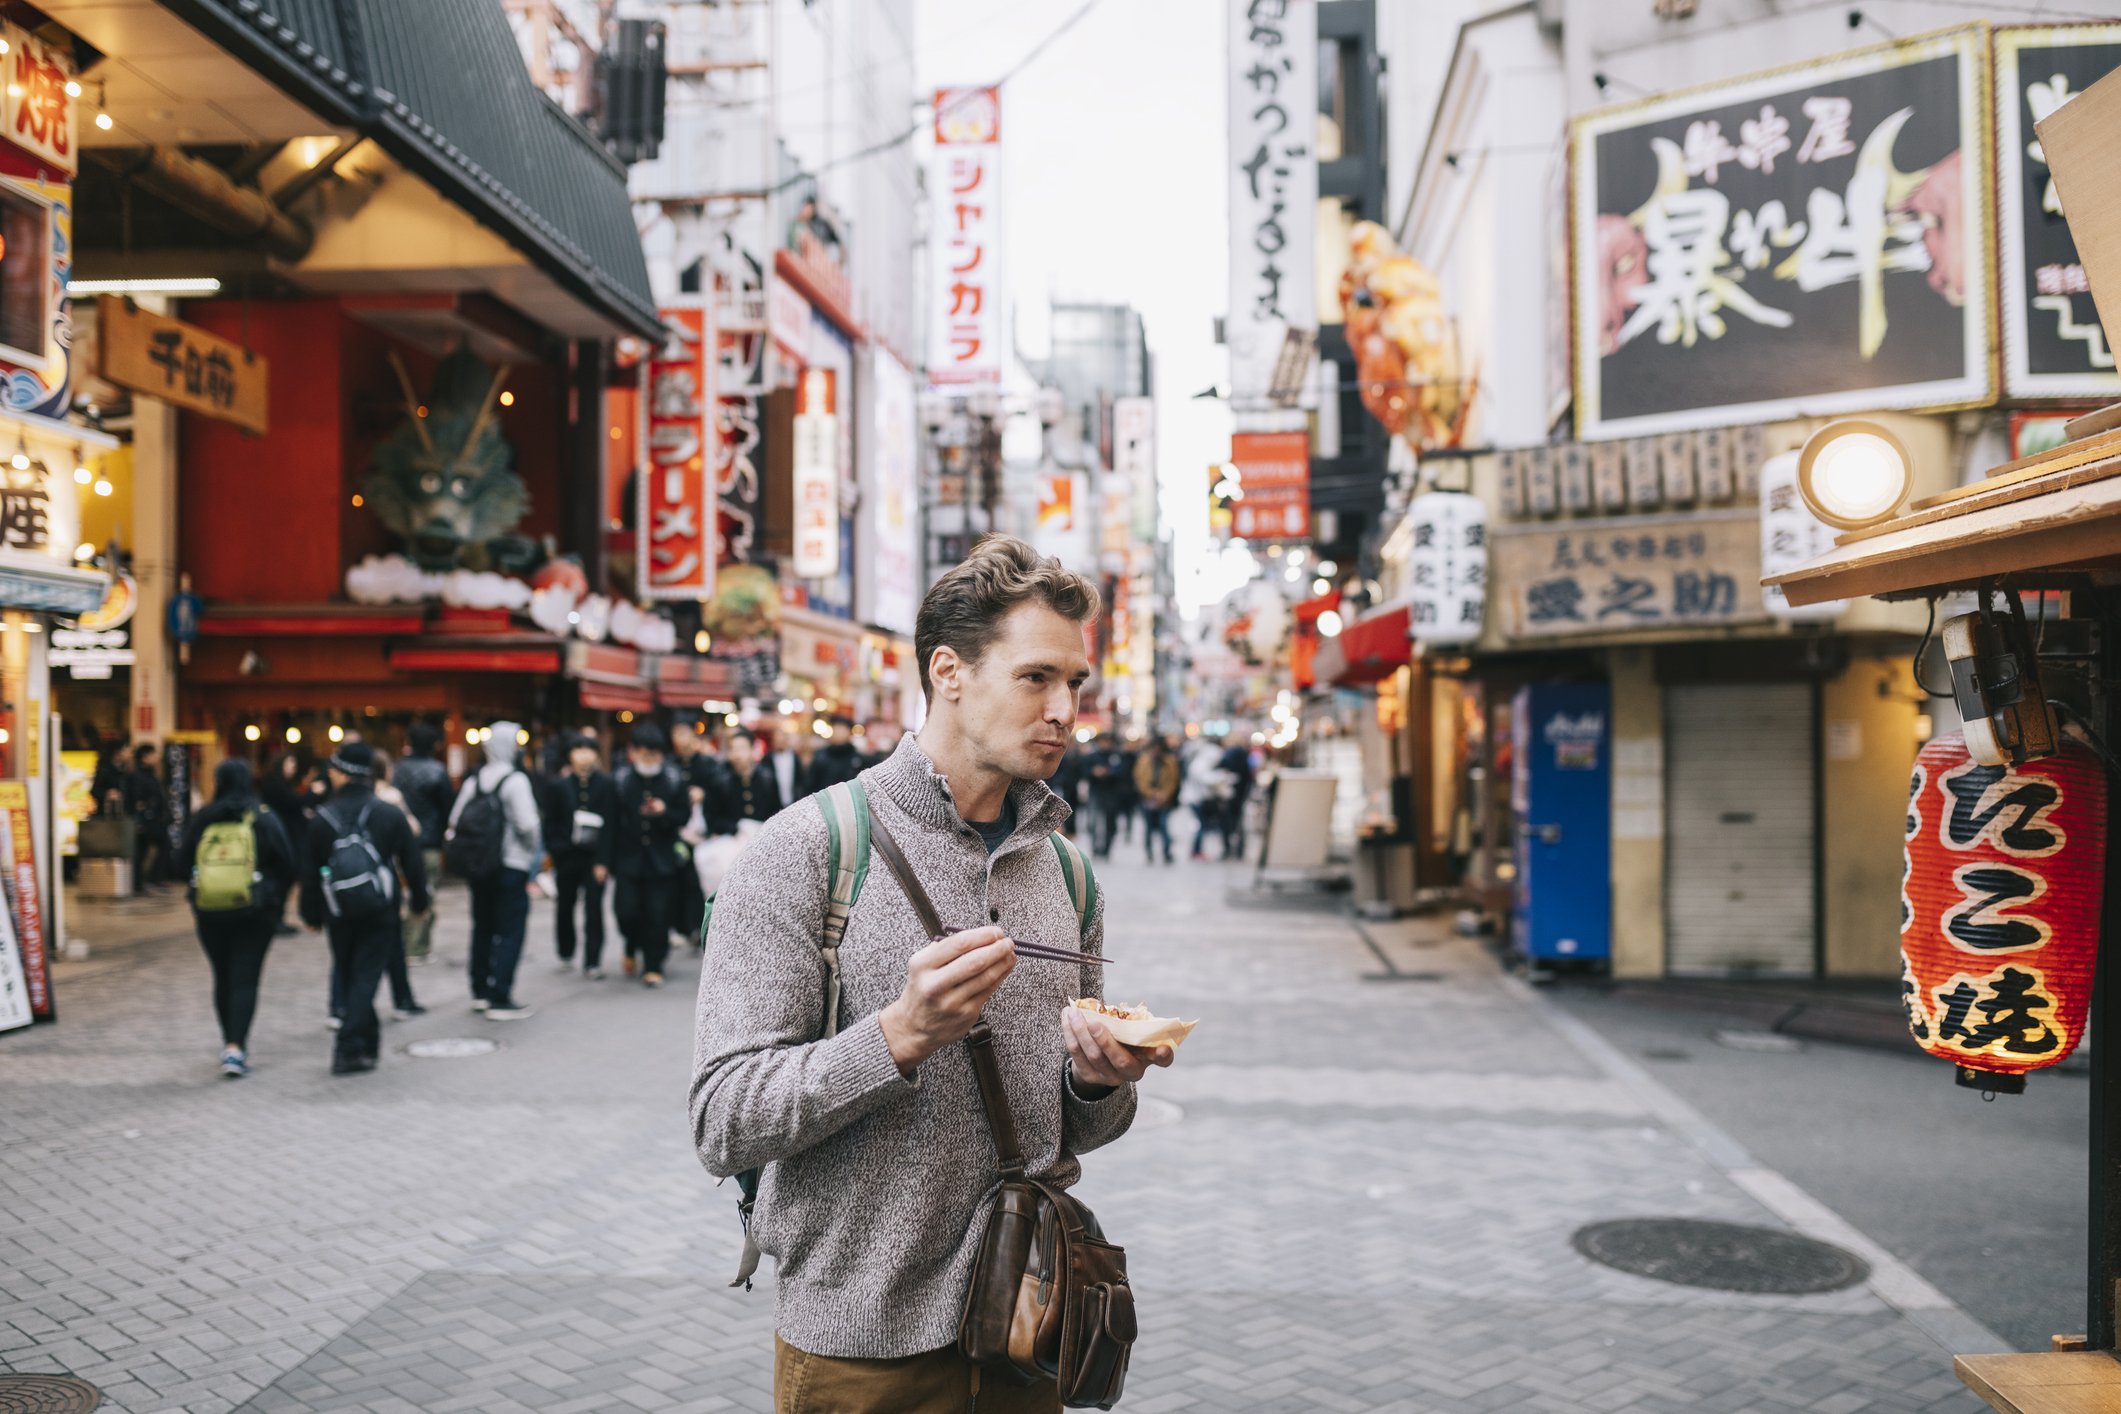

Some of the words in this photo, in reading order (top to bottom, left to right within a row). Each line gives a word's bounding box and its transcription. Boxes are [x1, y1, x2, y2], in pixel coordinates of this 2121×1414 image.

[1617, 105, 1933, 359] 暴れ牛
[1526, 570, 1738, 624] 愛之助
[1936, 763, 2062, 1057] たこ焼
